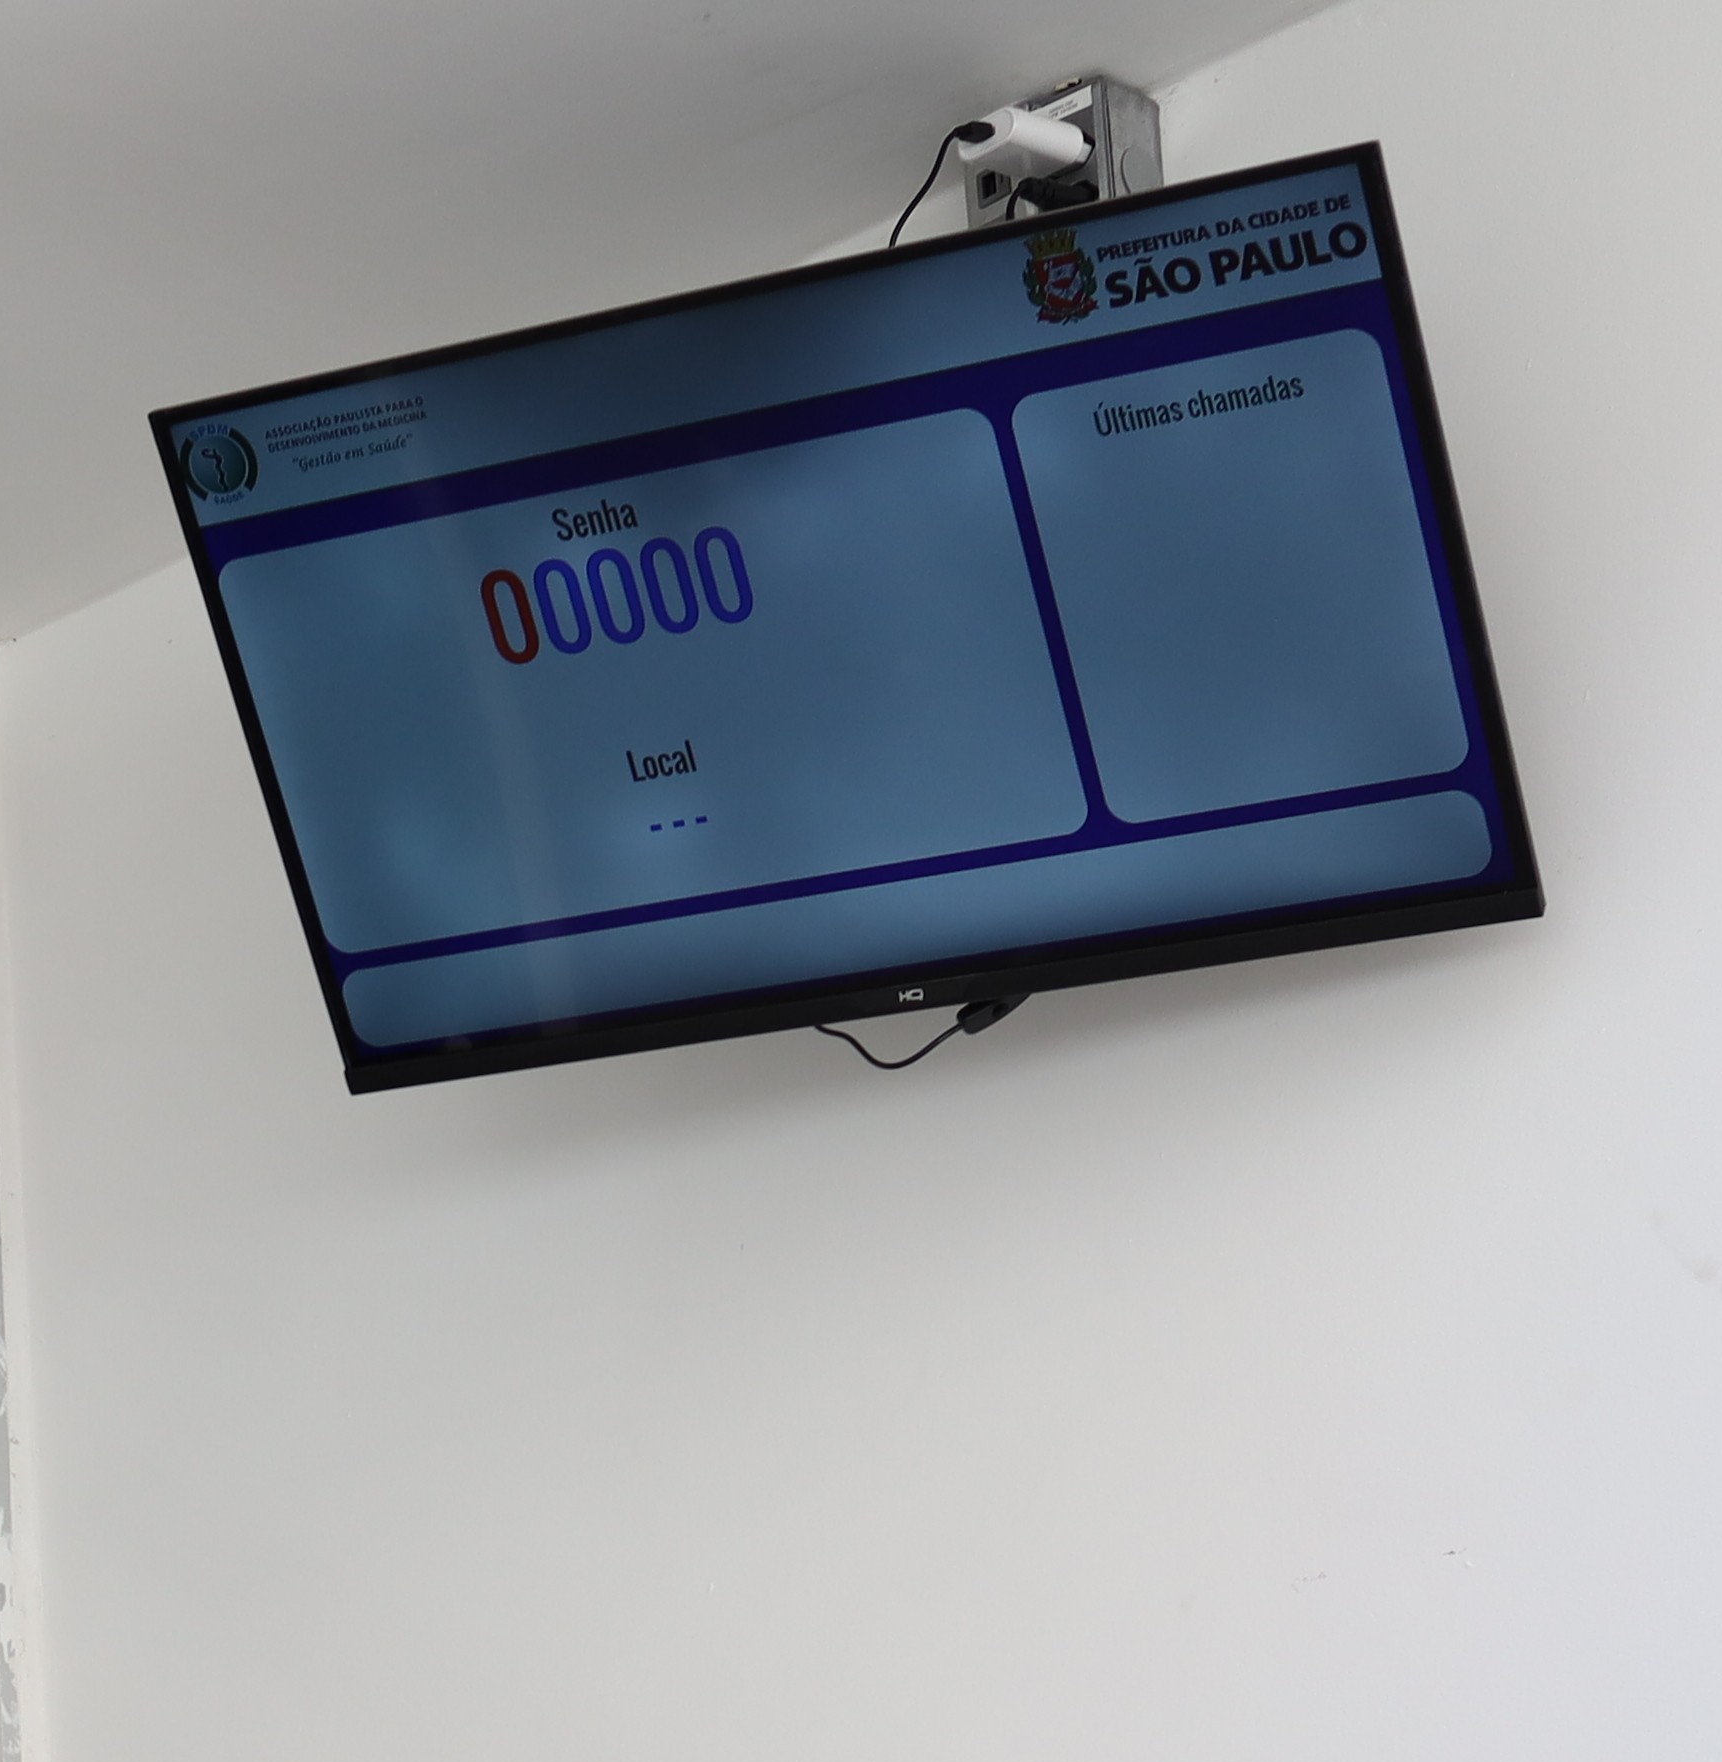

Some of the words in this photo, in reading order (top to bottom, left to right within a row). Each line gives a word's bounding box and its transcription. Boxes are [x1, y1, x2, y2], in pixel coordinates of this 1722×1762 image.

[1096, 224, 1212, 263] PREFEITURA
[1215, 216, 1246, 237] DA
[1248, 202, 1321, 232] CIDADE
[1324, 194, 1351, 215] DE
[1105, 256, 1202, 309] SÃO
[1210, 221, 1368, 287] PAULO
[265, 416, 332, 440] ASSOCIAÇÃO
[333, 407, 383, 425] PAULISTA
[385, 400, 414, 415] PARA
[415, 397, 424, 407] O
[1094, 400, 1184, 437] Últimas
[1188, 373, 1305, 418] chamadas
[189, 424, 229, 440] SPDM
[268, 427, 360, 454] DESENVOLVIMENTO
[362, 421, 376, 432] DA
[378, 410, 427, 429] MEDICINA
[345, 447, 364, 461] em
[552, 499, 639, 542] Senha
[480, 526, 754, 665] 00000
[626, 740, 698, 783] Local
[898, 987, 924, 1003] HQ
